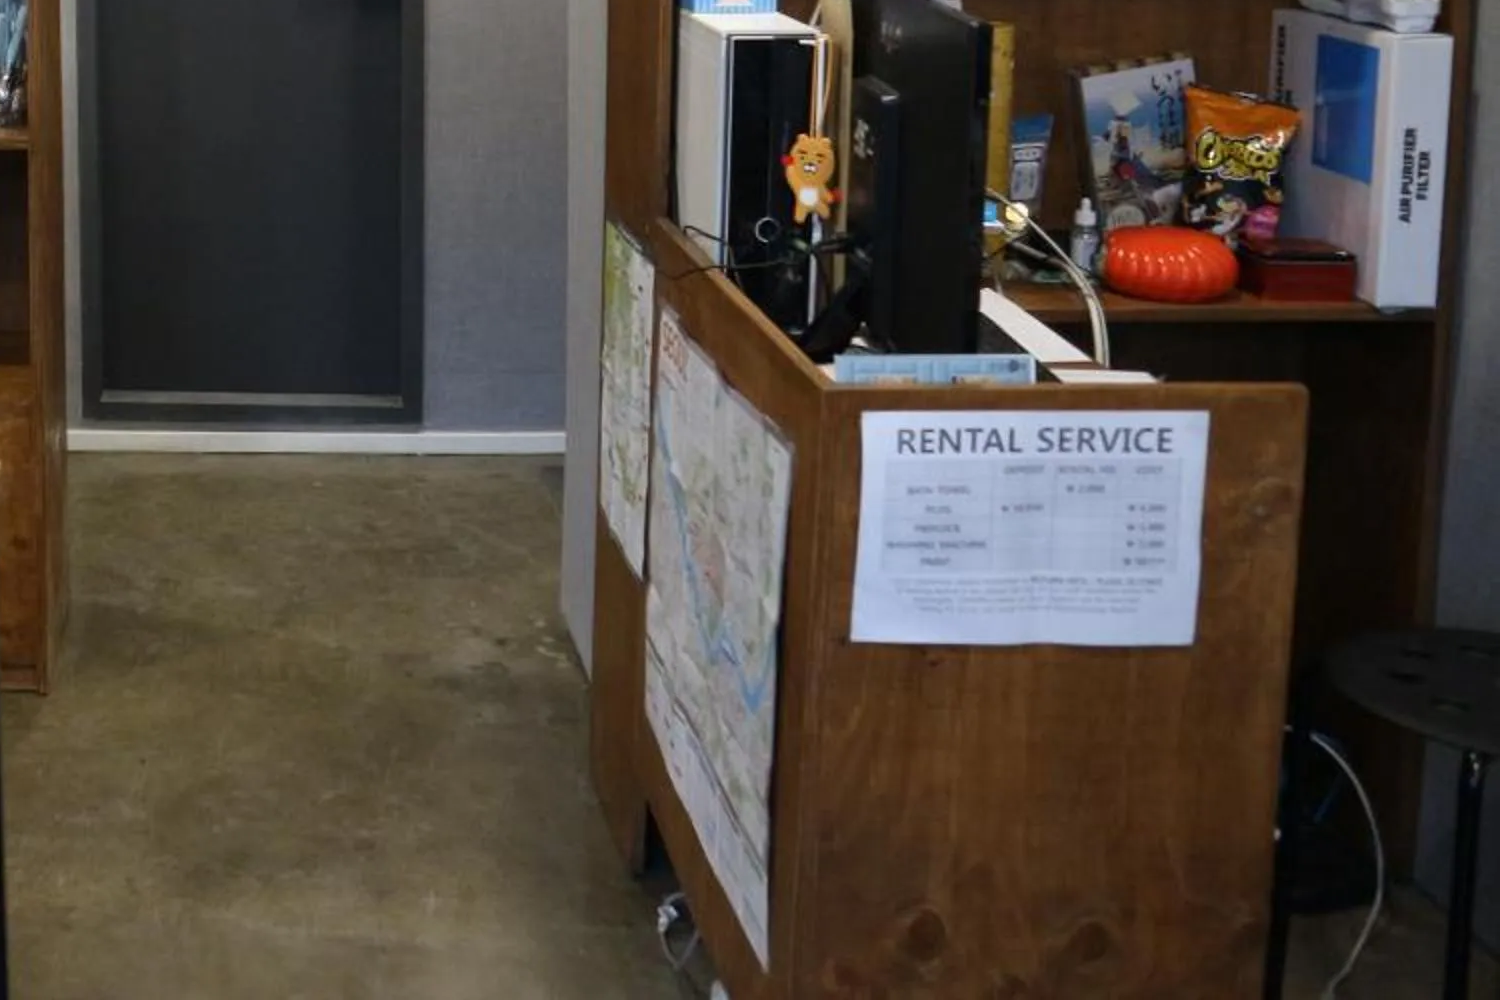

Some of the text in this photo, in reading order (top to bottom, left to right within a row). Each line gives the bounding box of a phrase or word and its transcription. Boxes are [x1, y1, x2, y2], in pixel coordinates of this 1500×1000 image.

[1398, 128, 1417, 223] AIR PURIFIER
[1415, 151, 1431, 201] FILTER
[896, 426, 1174, 455] RENTAL SERVICE
